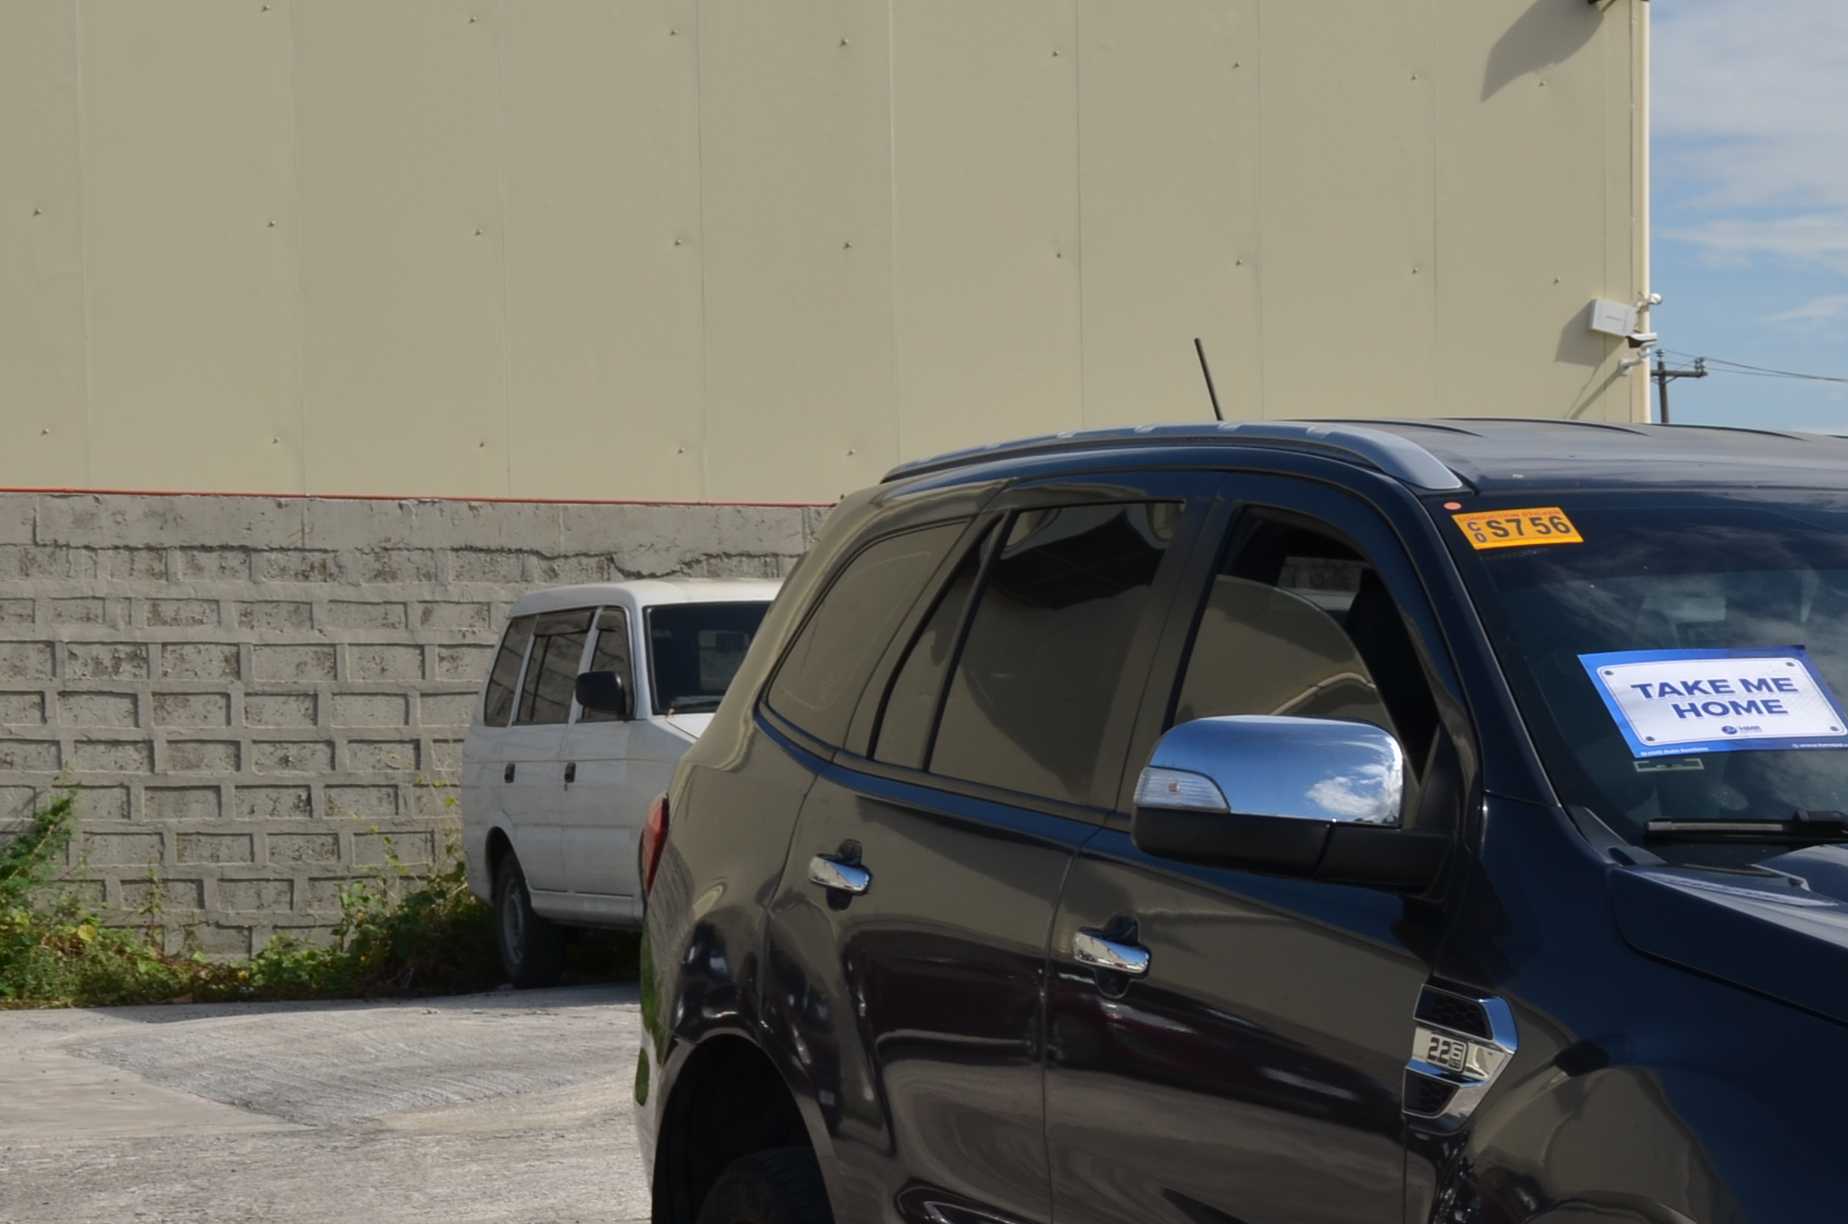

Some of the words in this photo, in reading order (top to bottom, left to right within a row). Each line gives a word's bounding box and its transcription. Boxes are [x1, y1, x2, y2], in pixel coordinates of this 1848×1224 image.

[1630, 679, 1735, 699] TAKE
[1738, 677, 1799, 693] ME
[1671, 699, 1789, 719] HOME
